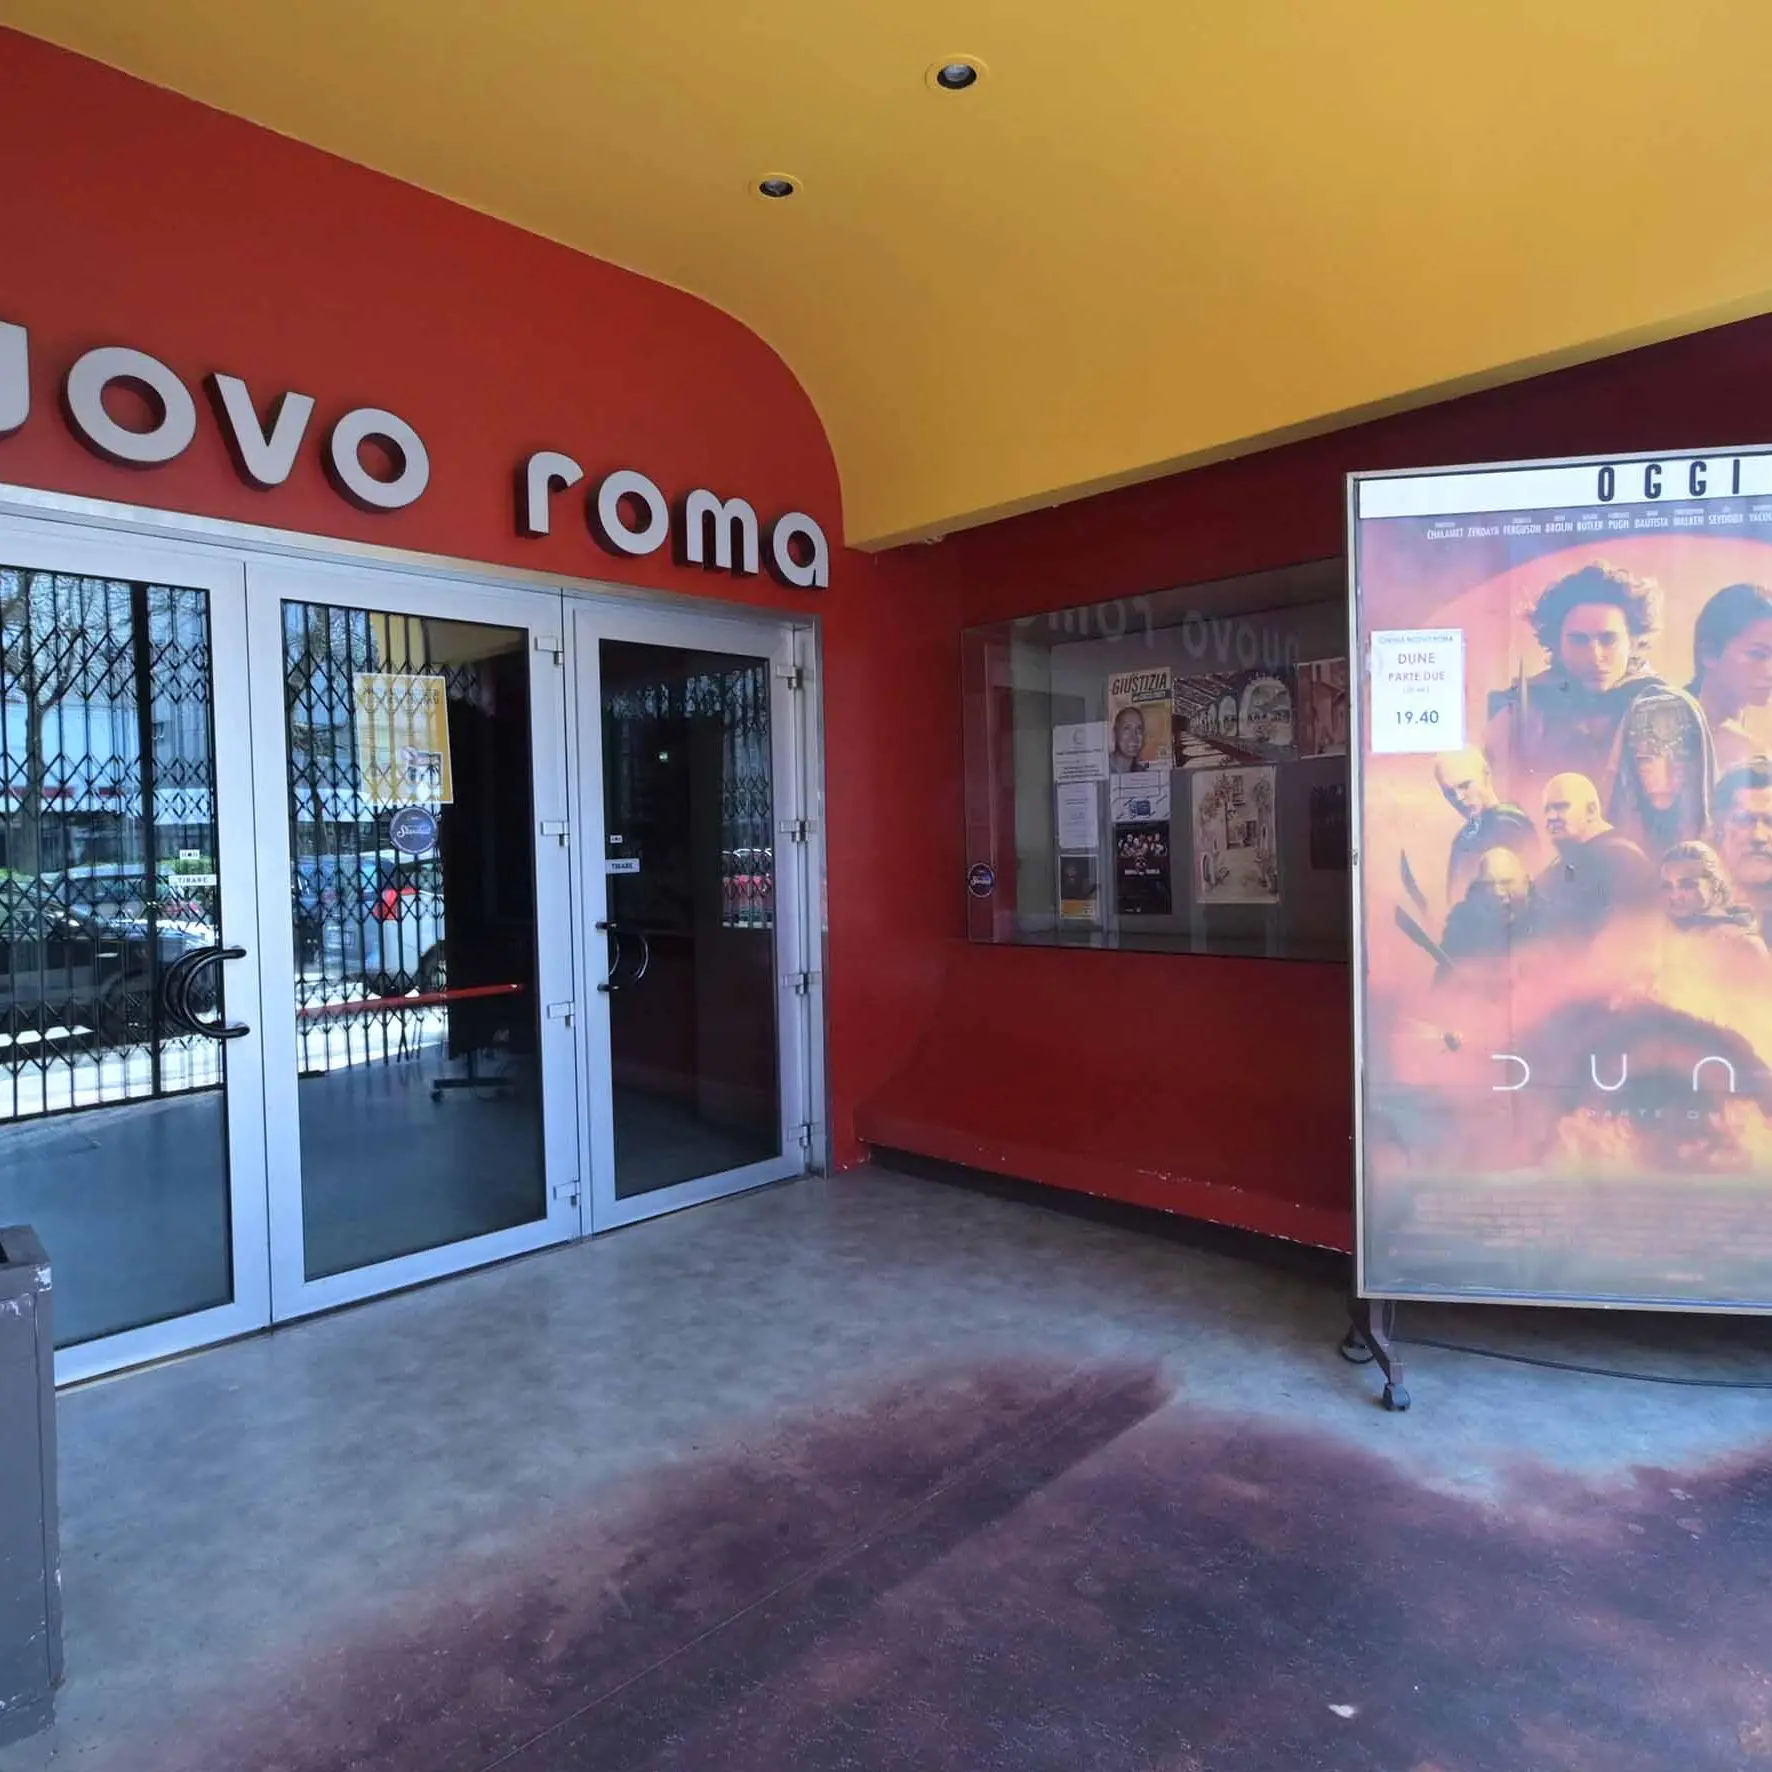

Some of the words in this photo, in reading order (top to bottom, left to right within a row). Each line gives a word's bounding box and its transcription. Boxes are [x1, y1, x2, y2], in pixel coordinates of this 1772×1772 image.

[0, 320, 430, 510] ovo
[520, 450, 829, 588] roma
[1597, 458, 1741, 502] OGGI
[1607, 518, 1629, 530] PUGH
[1397, 652, 1436, 665] DUNE
[1388, 671, 1420, 681] PARTE
[1423, 670, 1446, 681] DUE
[1112, 672, 1167, 696] GIUSTIZIA
[1396, 710, 1439, 725] 19.40
